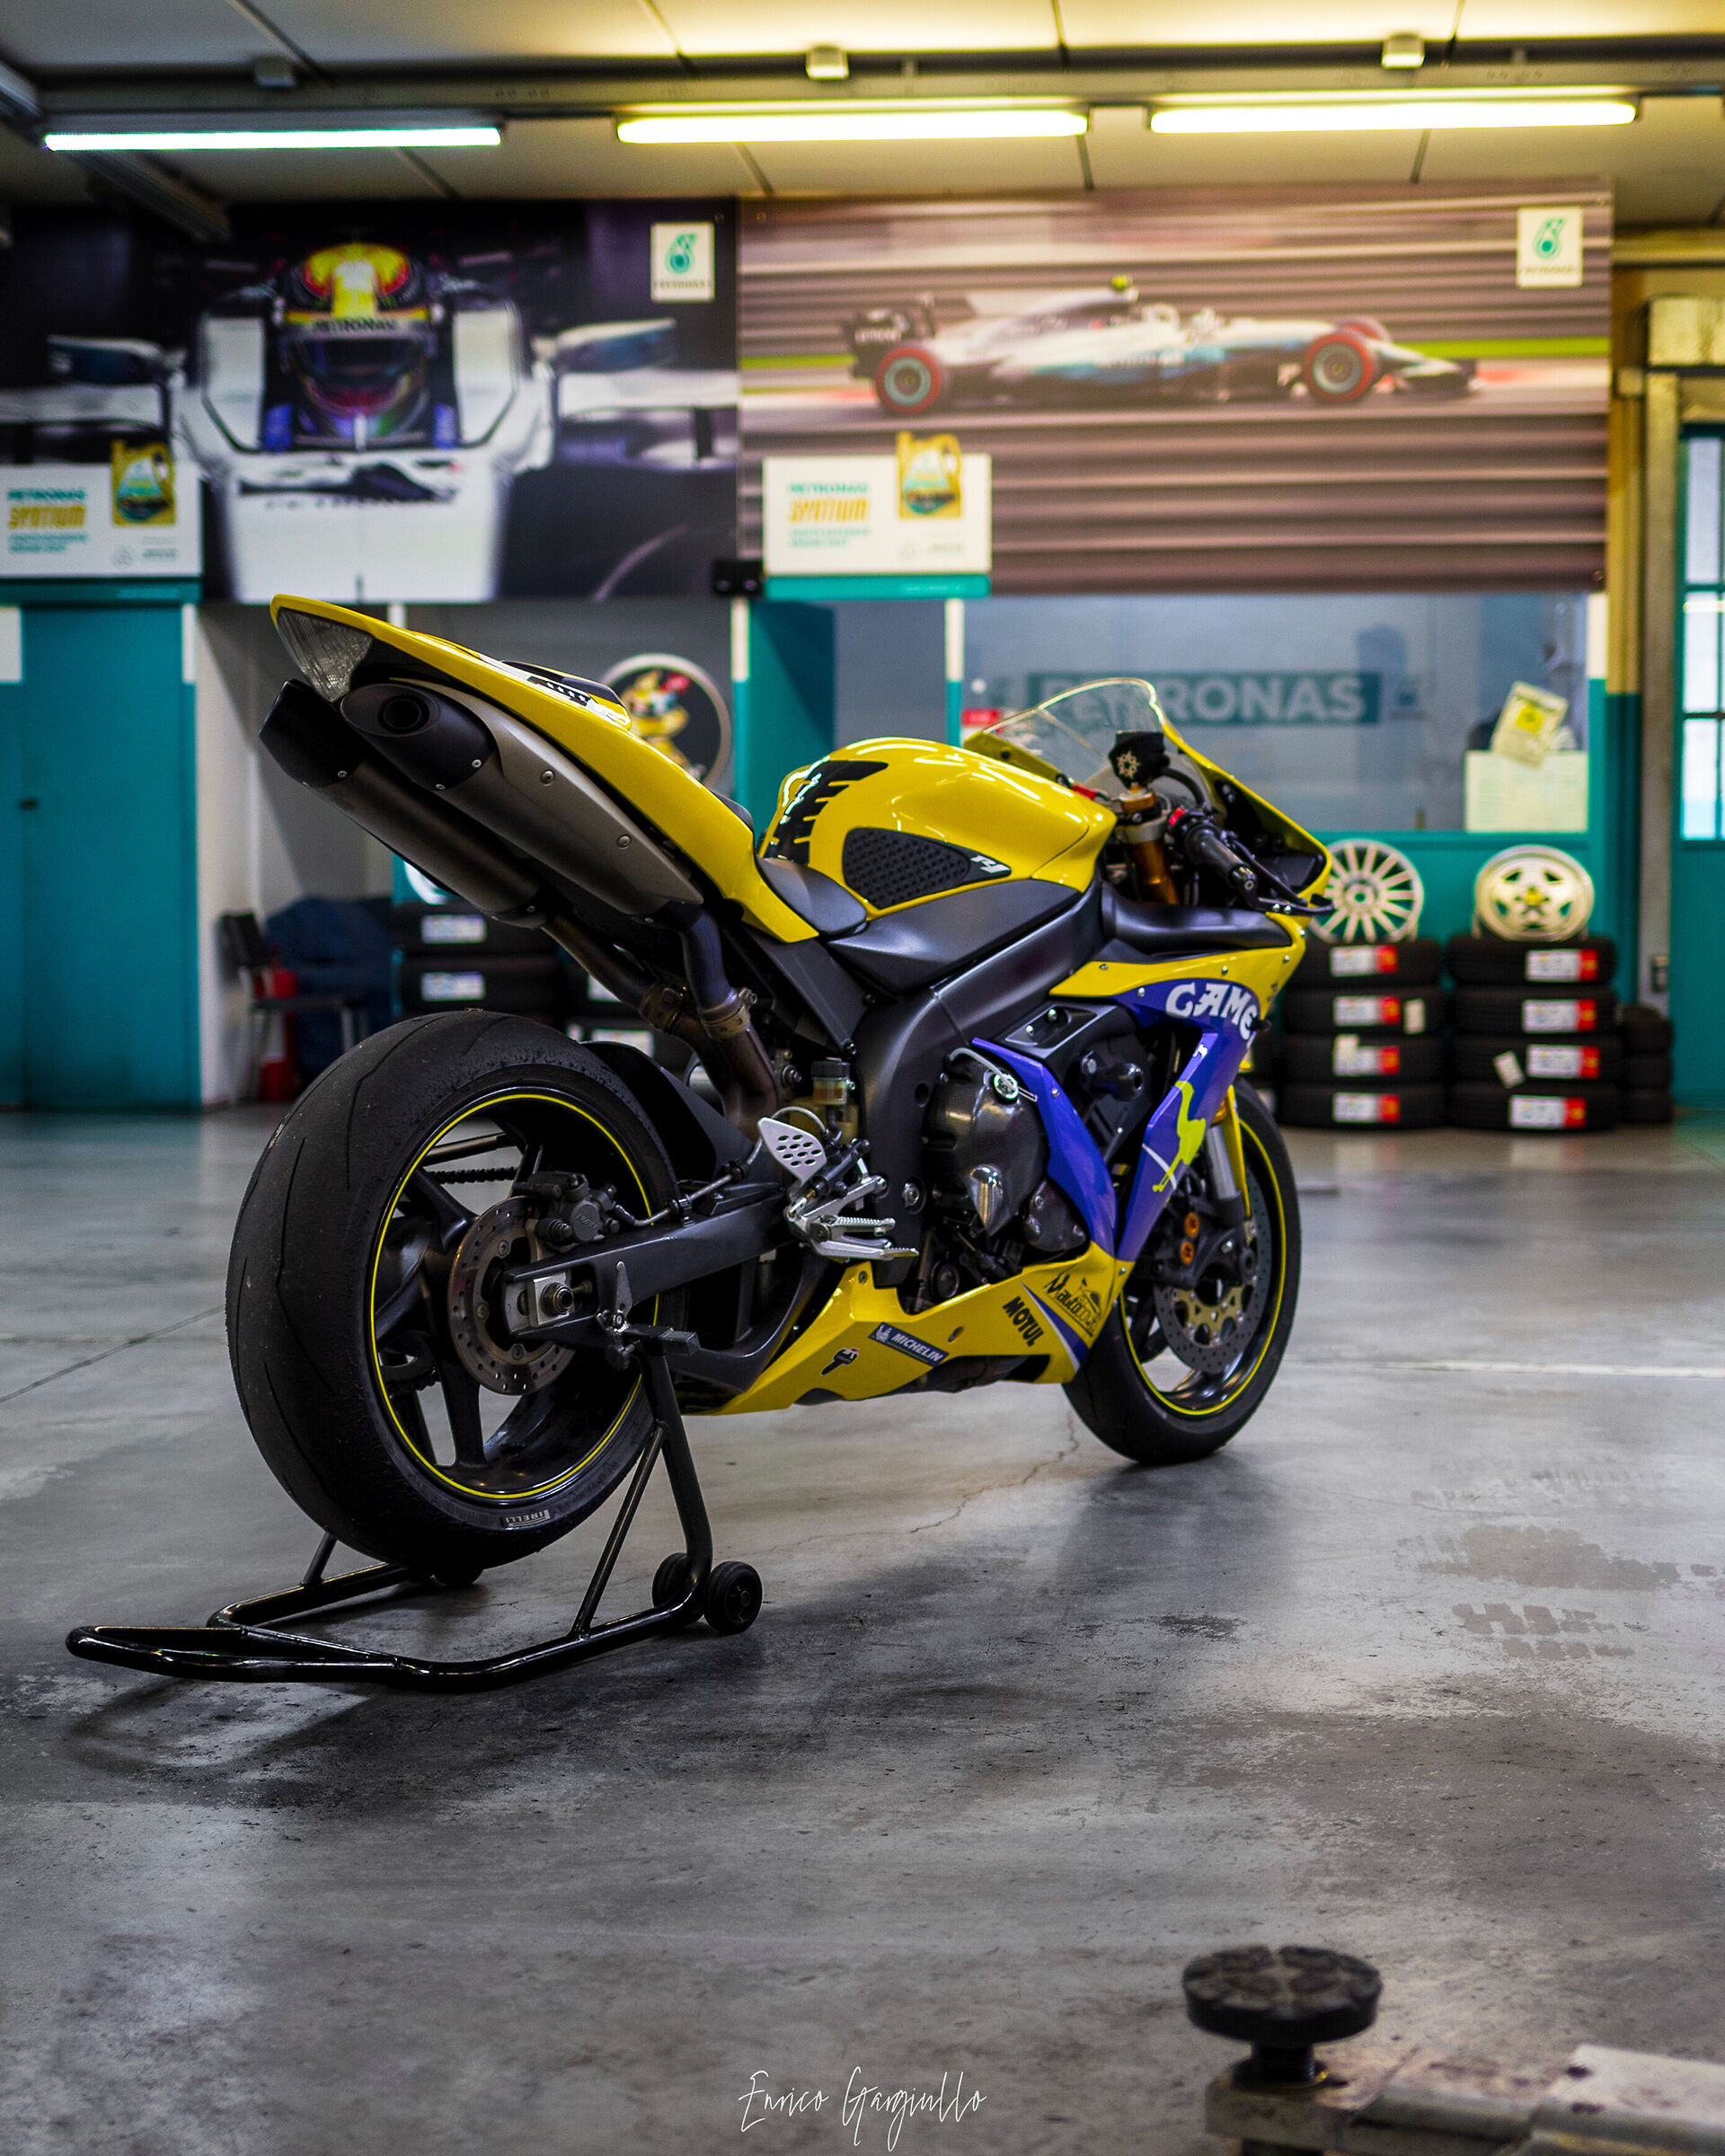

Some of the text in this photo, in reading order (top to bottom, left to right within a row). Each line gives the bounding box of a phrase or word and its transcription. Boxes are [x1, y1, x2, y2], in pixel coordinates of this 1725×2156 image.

[1003, 1296, 1045, 1348] MOTUL
[891, 1332, 943, 1364] MICHELIN
[505, 1509, 551, 1526] PIRELLI
